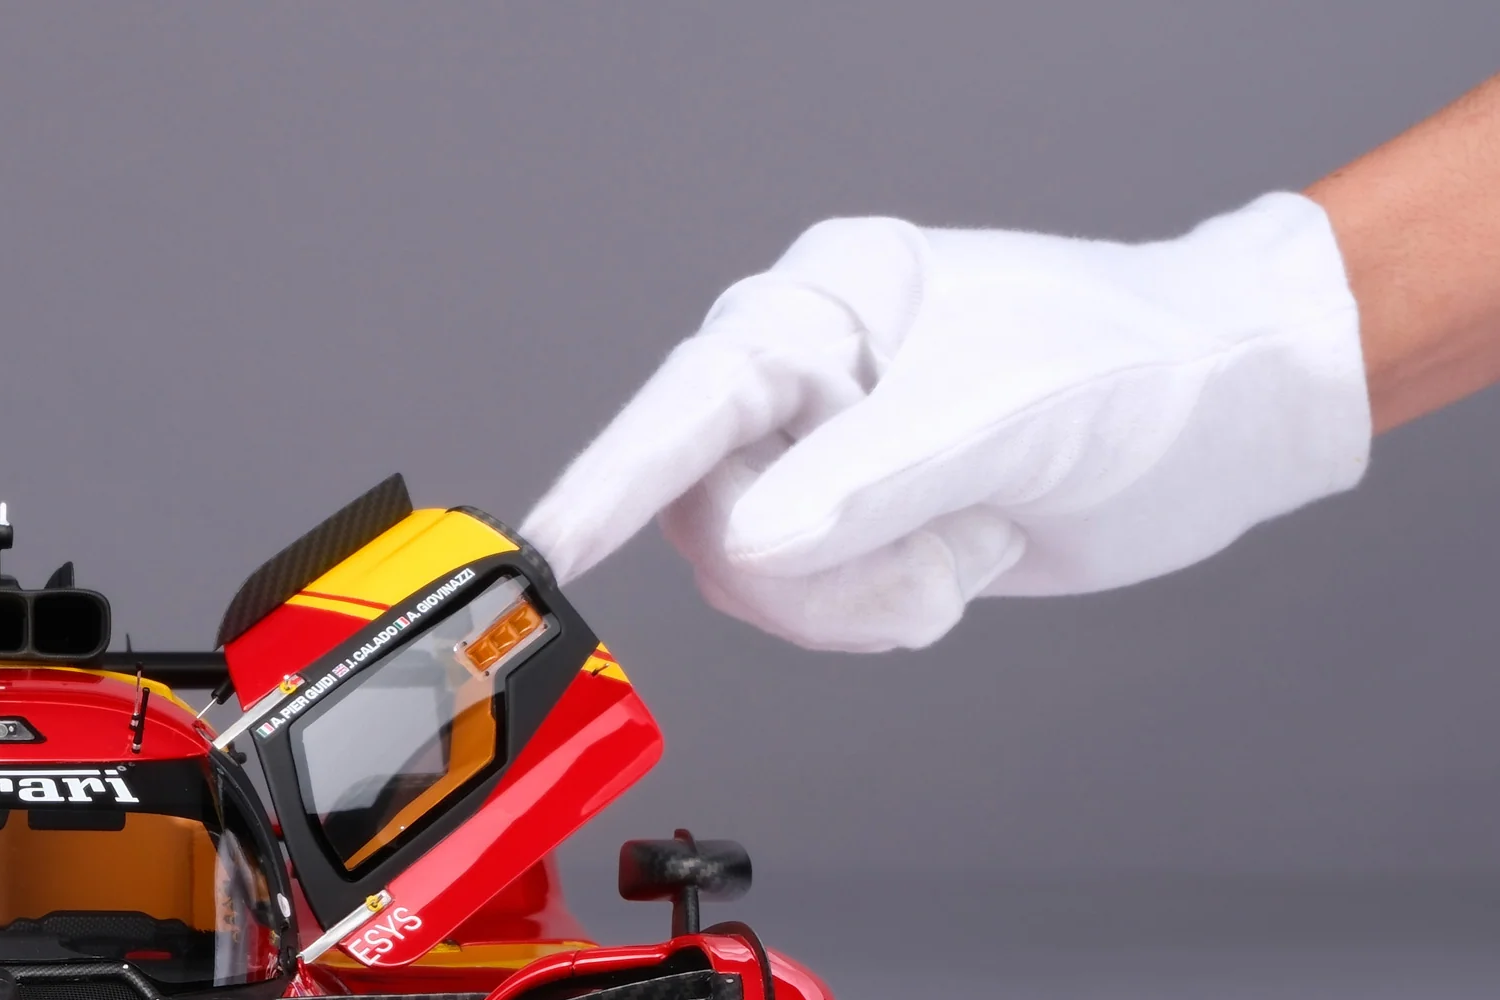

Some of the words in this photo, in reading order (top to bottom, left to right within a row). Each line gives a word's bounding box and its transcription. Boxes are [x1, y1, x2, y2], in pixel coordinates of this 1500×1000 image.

[270, 717, 286, 728] A.
[280, 696, 310, 719] PIER
[304, 673, 337, 700] GUIDI
[346, 659, 358, 669] J.
[352, 625, 399, 662] CALADO
[407, 611, 421, 622] A.
[417, 568, 475, 613] GIOVINAZZI
[348, 907, 422, 966] ESYS
